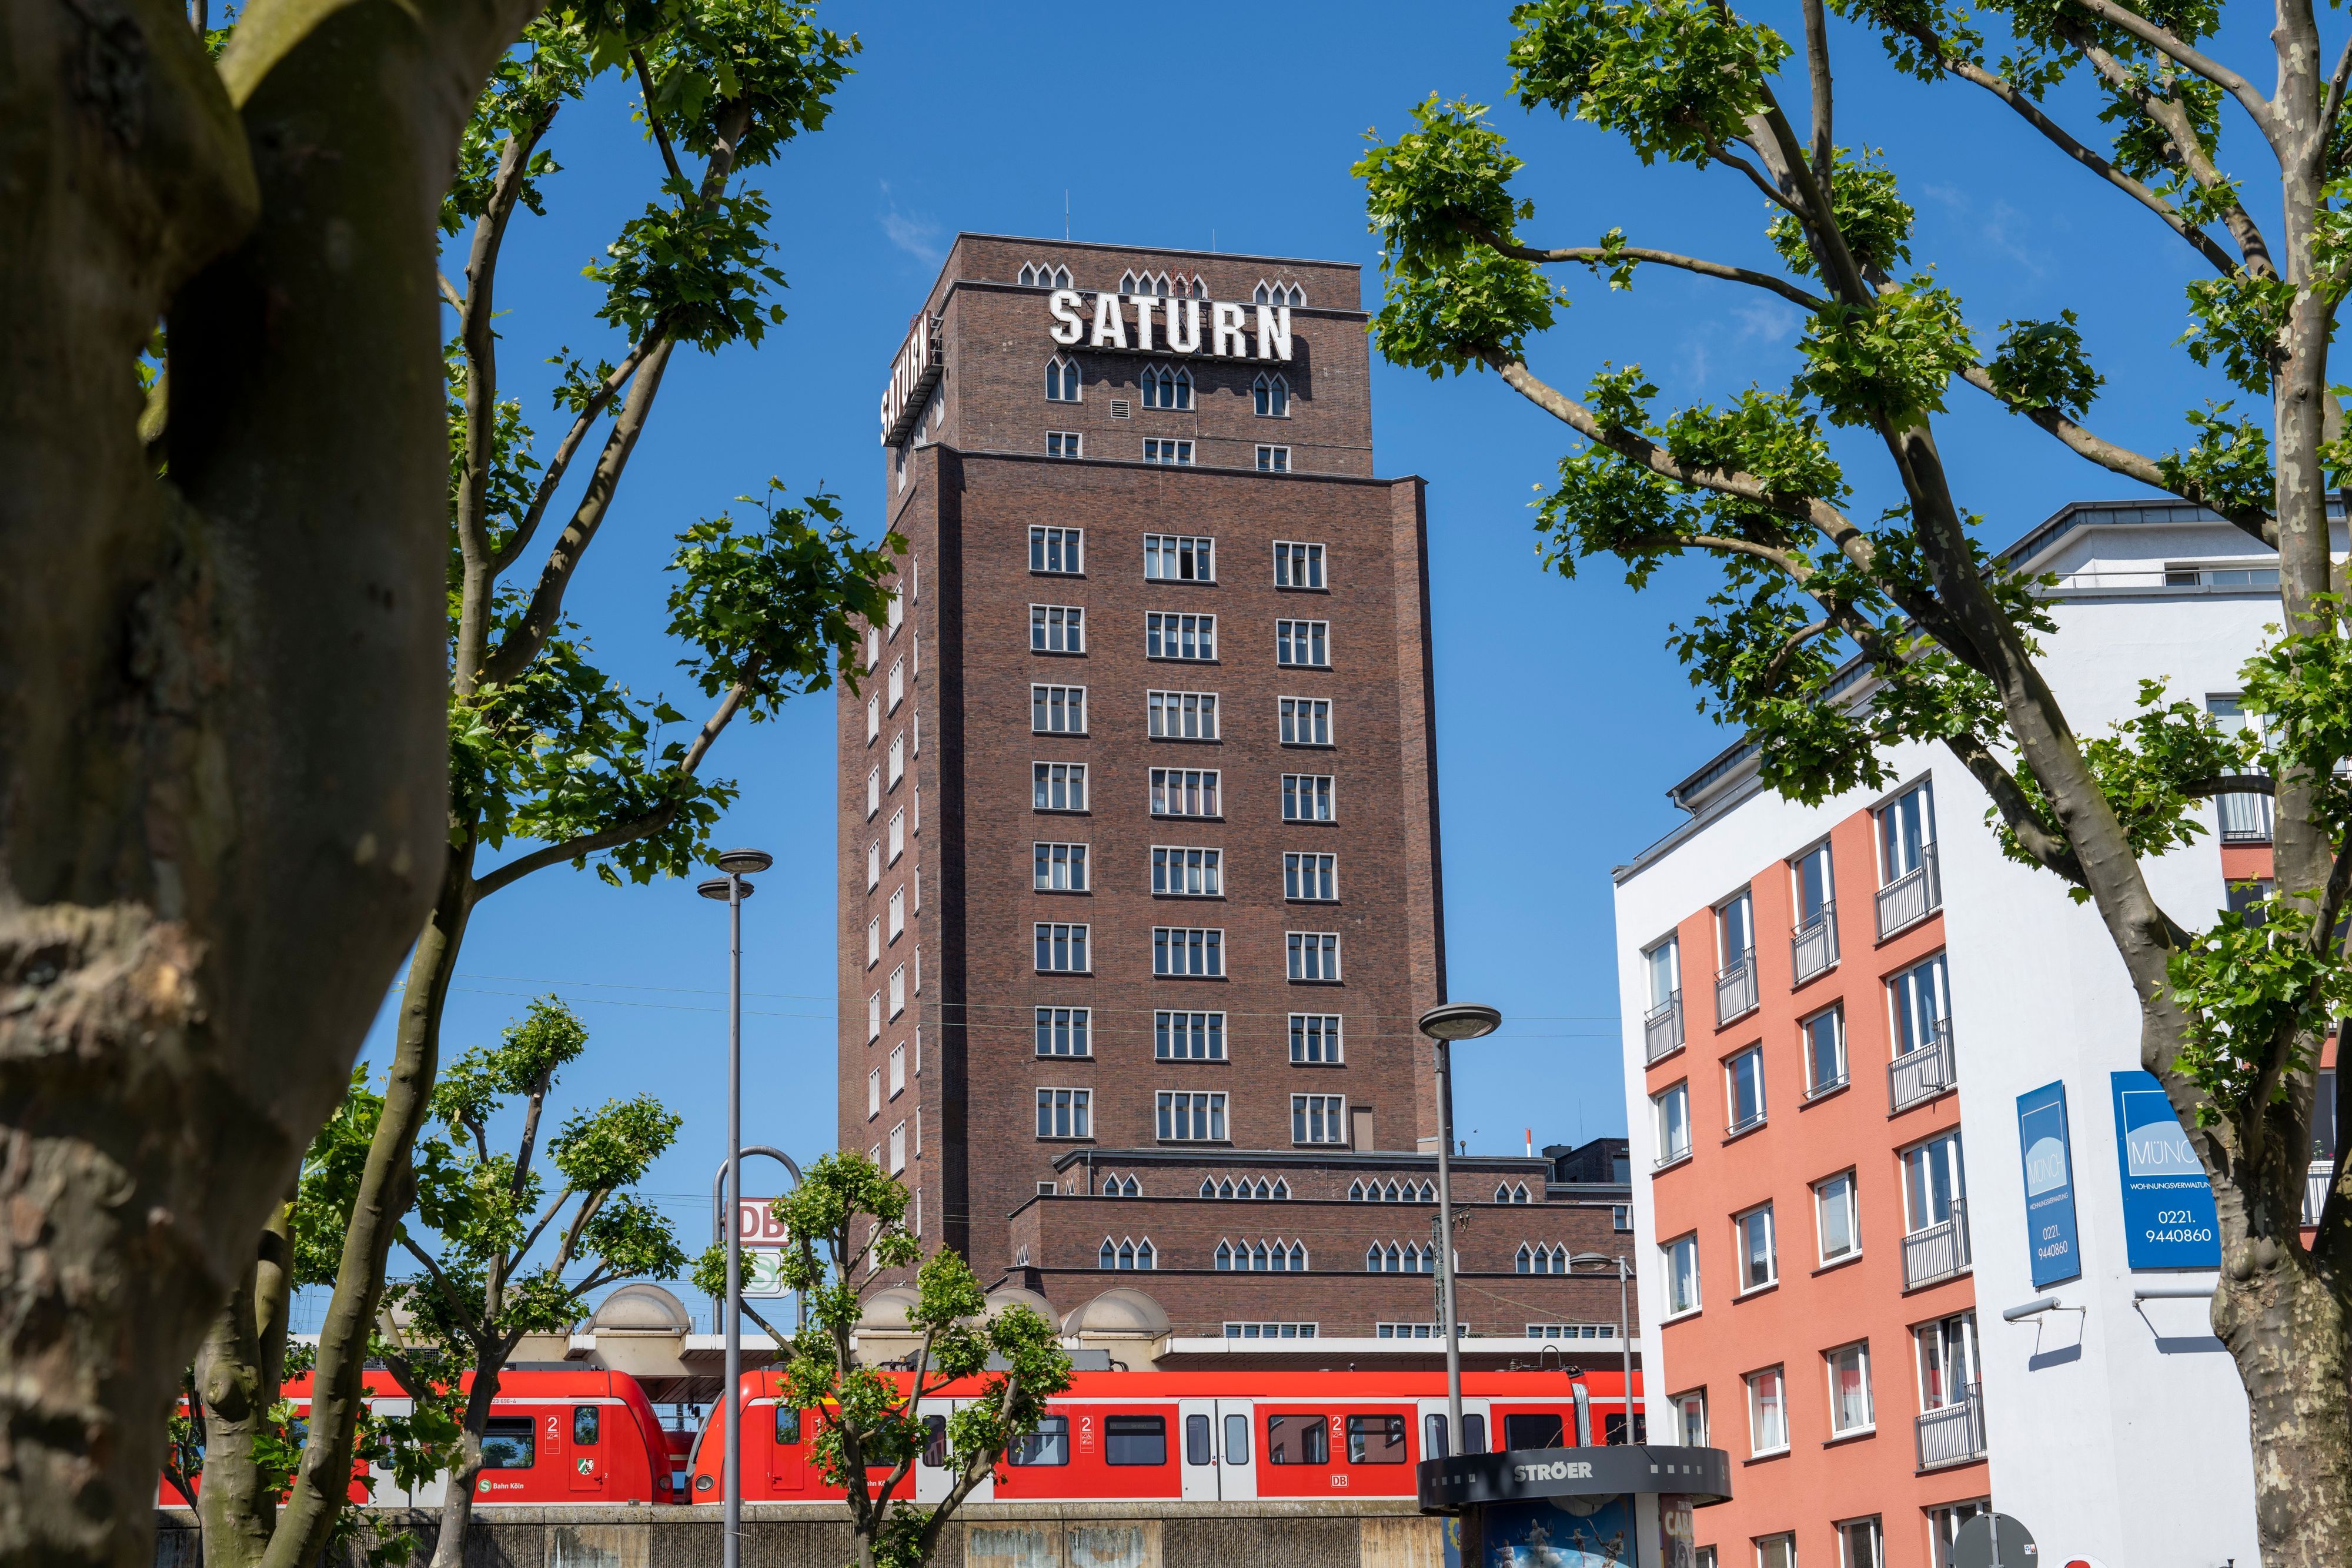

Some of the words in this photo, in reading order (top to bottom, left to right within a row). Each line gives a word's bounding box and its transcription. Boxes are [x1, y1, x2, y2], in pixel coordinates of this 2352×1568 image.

[1049, 288, 1292, 361] SATURN
[880, 311, 930, 447] SATURN
[2132, 1139, 2199, 1165] MÜNC
[2028, 1152, 2063, 1185] MÜNCH
[2130, 1182, 2211, 1190] WOHNUNGSVERWALTUN
[2029, 1192, 2069, 1211] WOHNUNGSVERWALTUNG
[740, 1206, 785, 1238] DB
[2158, 1210, 2196, 1224] 0221.
[2043, 1224, 2060, 1241] 0221.
[2146, 1228, 2211, 1242] 9440860
[2038, 1241, 2068, 1261] 9440860
[547, 1416, 557, 1432] 2
[1081, 1417, 1091, 1432] 2
[1332, 1416, 1342, 1430] 2
[1514, 1461, 1593, 1482] STRÖER
[479, 1480, 490, 1492] S
[1332, 1476, 1347, 1485] DB
